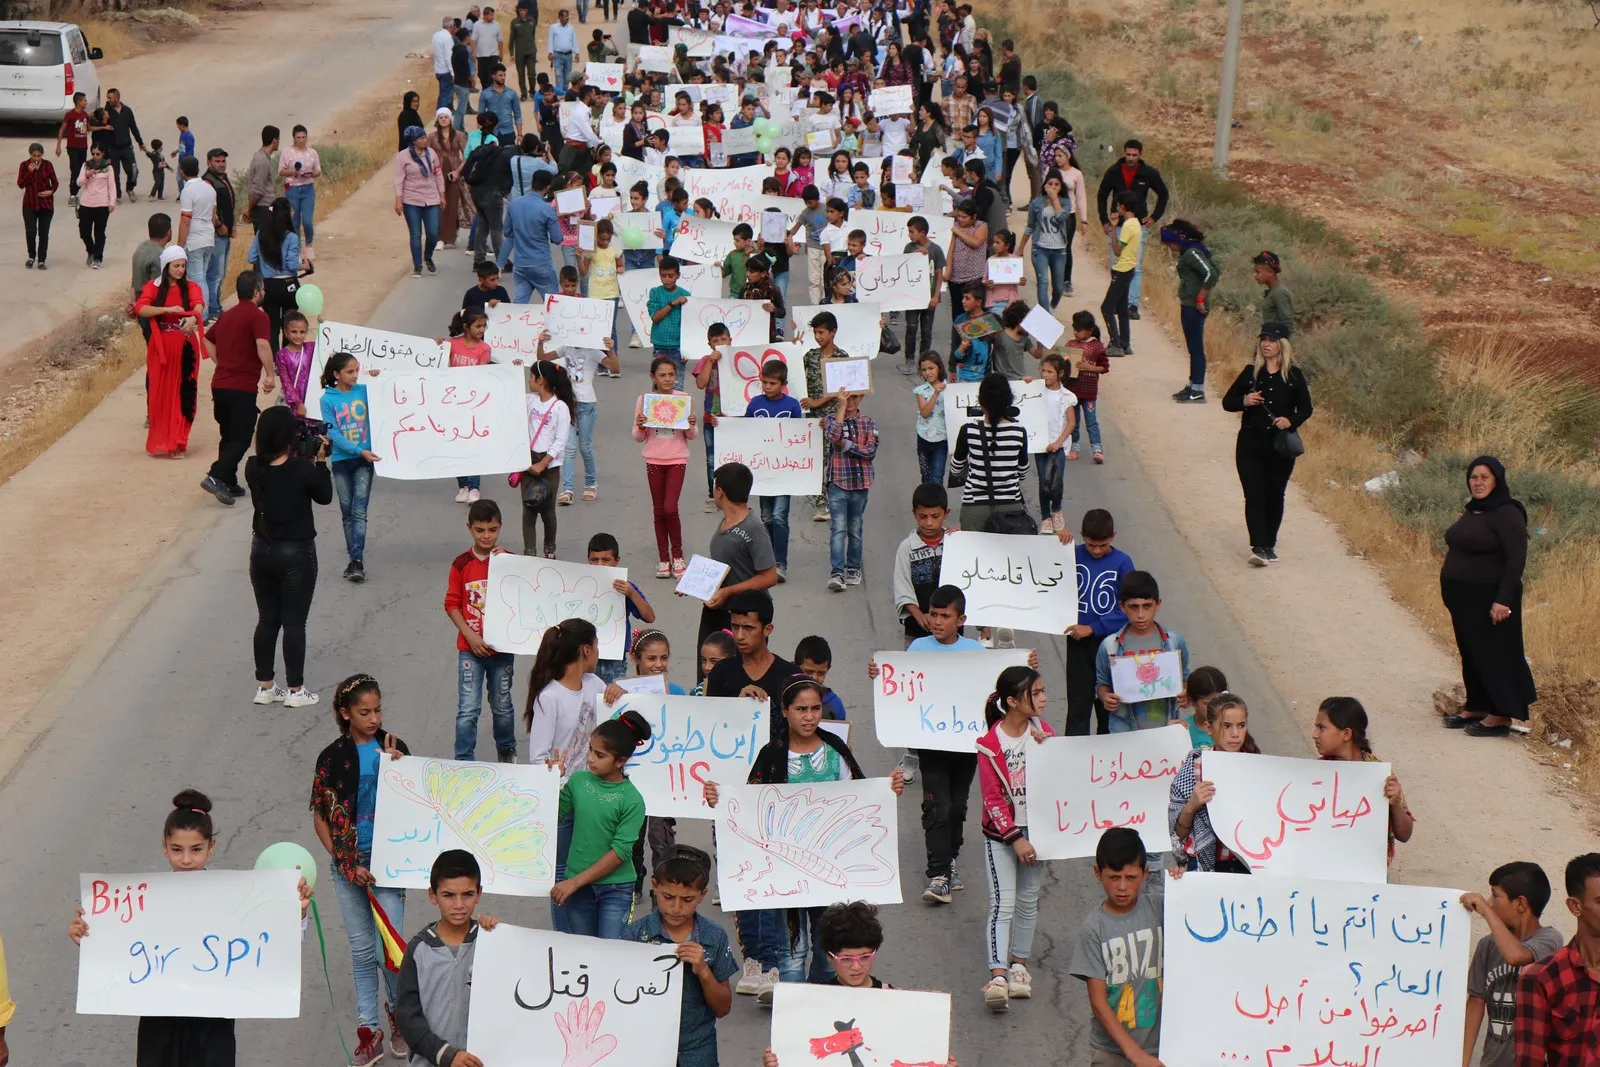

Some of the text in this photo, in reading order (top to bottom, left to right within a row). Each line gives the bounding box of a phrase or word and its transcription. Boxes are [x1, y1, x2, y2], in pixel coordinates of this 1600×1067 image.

[371, 340, 413, 360] حقوق
[1027, 556, 1063, 593] تحيا
[882, 664, 924, 702] Bijî
[710, 711, 761, 765] أين
[1056, 800, 1146, 835] شعارنا
[1276, 770, 1372, 832] حياتي
[387, 813, 441, 845] أريد
[91, 880, 148, 923] Bijî
[1184, 891, 1300, 943] أطفال
[1311, 896, 1328, 947] يا
[1391, 900, 1448, 949] أين
[514, 946, 590, 1011] قتل
[1374, 963, 1444, 1009] العالم
[1234, 979, 1309, 1026] أجل
[1318, 998, 1352, 1025] من
